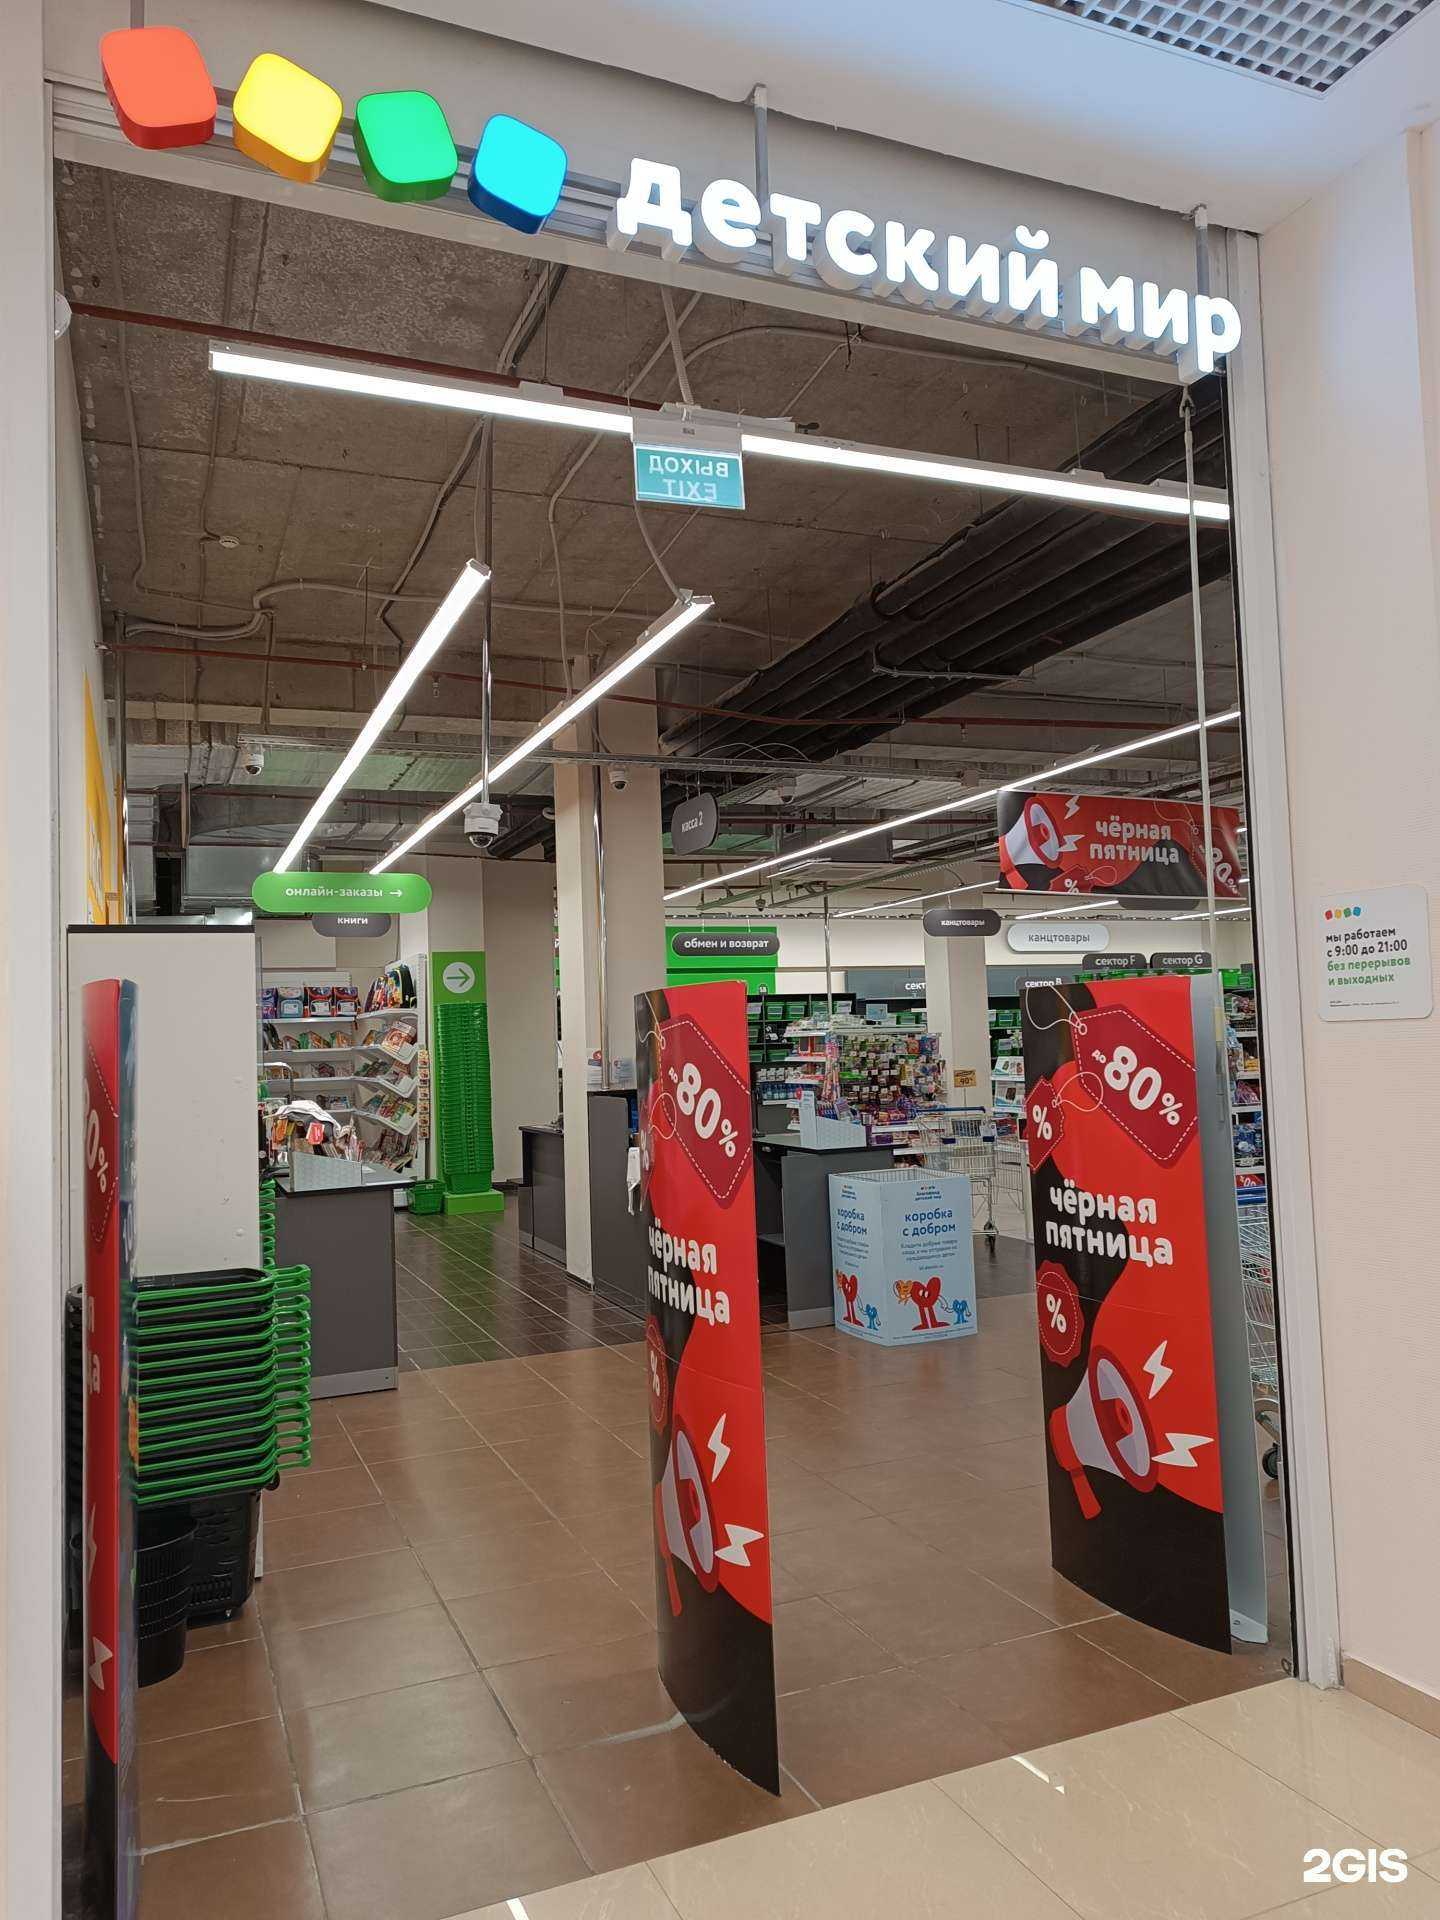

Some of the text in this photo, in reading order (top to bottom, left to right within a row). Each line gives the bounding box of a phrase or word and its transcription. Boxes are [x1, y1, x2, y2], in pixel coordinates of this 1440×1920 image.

[616, 157, 1242, 374] детский мир
[681, 811, 704, 833] касса 2
[1096, 815, 1171, 841] чёрная
[1089, 843, 1179, 866] пятница
[285, 886, 383, 897] онлайн-заказы
[337, 916, 369, 925] книги
[941, 918, 985, 928] канцтовары
[1028, 932, 1090, 945] канцтовары
[1326, 928, 1396, 944] мы работаем
[684, 938, 769, 950] обмен и возврат
[1327, 939, 1407, 957] с 9:00 до 21:00
[1095, 955, 1136, 968] сектор F
[1162, 955, 1203, 967] сектор G
[1327, 957, 1411, 971] без перерывов
[1328, 974, 1395, 986] и выходных
[1091, 1049, 1107, 1064] до
[668, 1066, 678, 1084] до
[1050, 1178, 1157, 1225] чёрная
[837, 1208, 865, 1221] коробка
[905, 1208, 953, 1223] коробка
[841, 1222, 867, 1235] добром
[902, 1223, 956, 1237] с добром
[648, 1217, 718, 1275] чёрная
[1045, 1221, 1174, 1268] пятница
[648, 1265, 731, 1326] пятница
